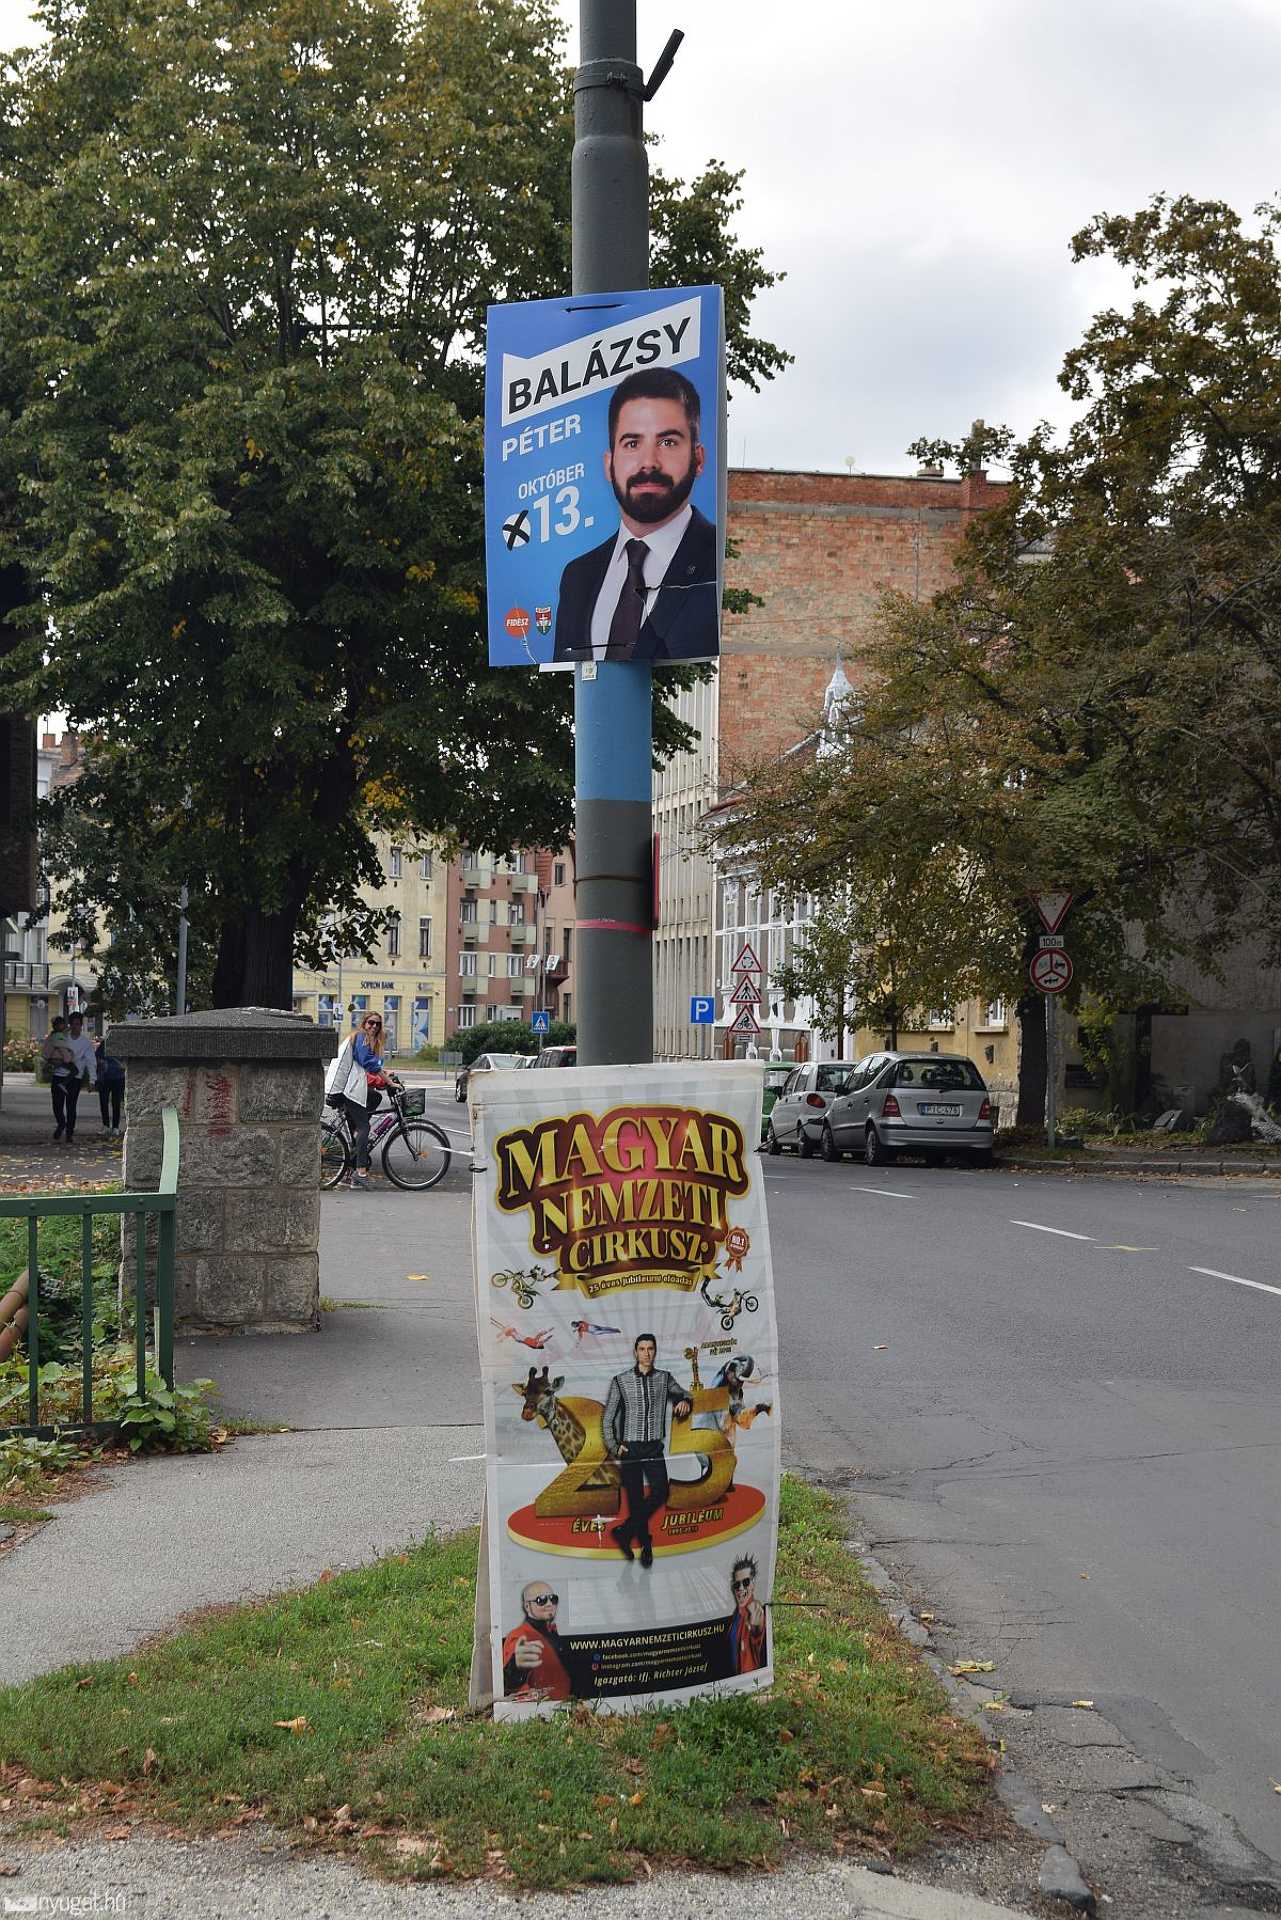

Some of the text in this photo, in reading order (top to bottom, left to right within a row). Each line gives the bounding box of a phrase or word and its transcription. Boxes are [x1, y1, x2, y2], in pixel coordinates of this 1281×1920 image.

[508, 317, 692, 415] BALÁZSY
[502, 413, 582, 463] PÉTER
[518, 463, 585, 499] OKTÓBER
[533, 486, 595, 544] 13.
[360, 980, 394, 990] SOPRON BANK
[695, 1000, 710, 1021] P
[504, 1116, 743, 1198] MAGYAR
[539, 1177, 723, 1242] NEMZETI
[568, 1226, 709, 1271] CIRKUSZ
[572, 1516, 606, 1533] ÉVES
[570, 1623, 725, 1651] WWW.MAGYARNEMZETICIRKUSZ.HU
[653, 1668, 683, 1680] Richter
